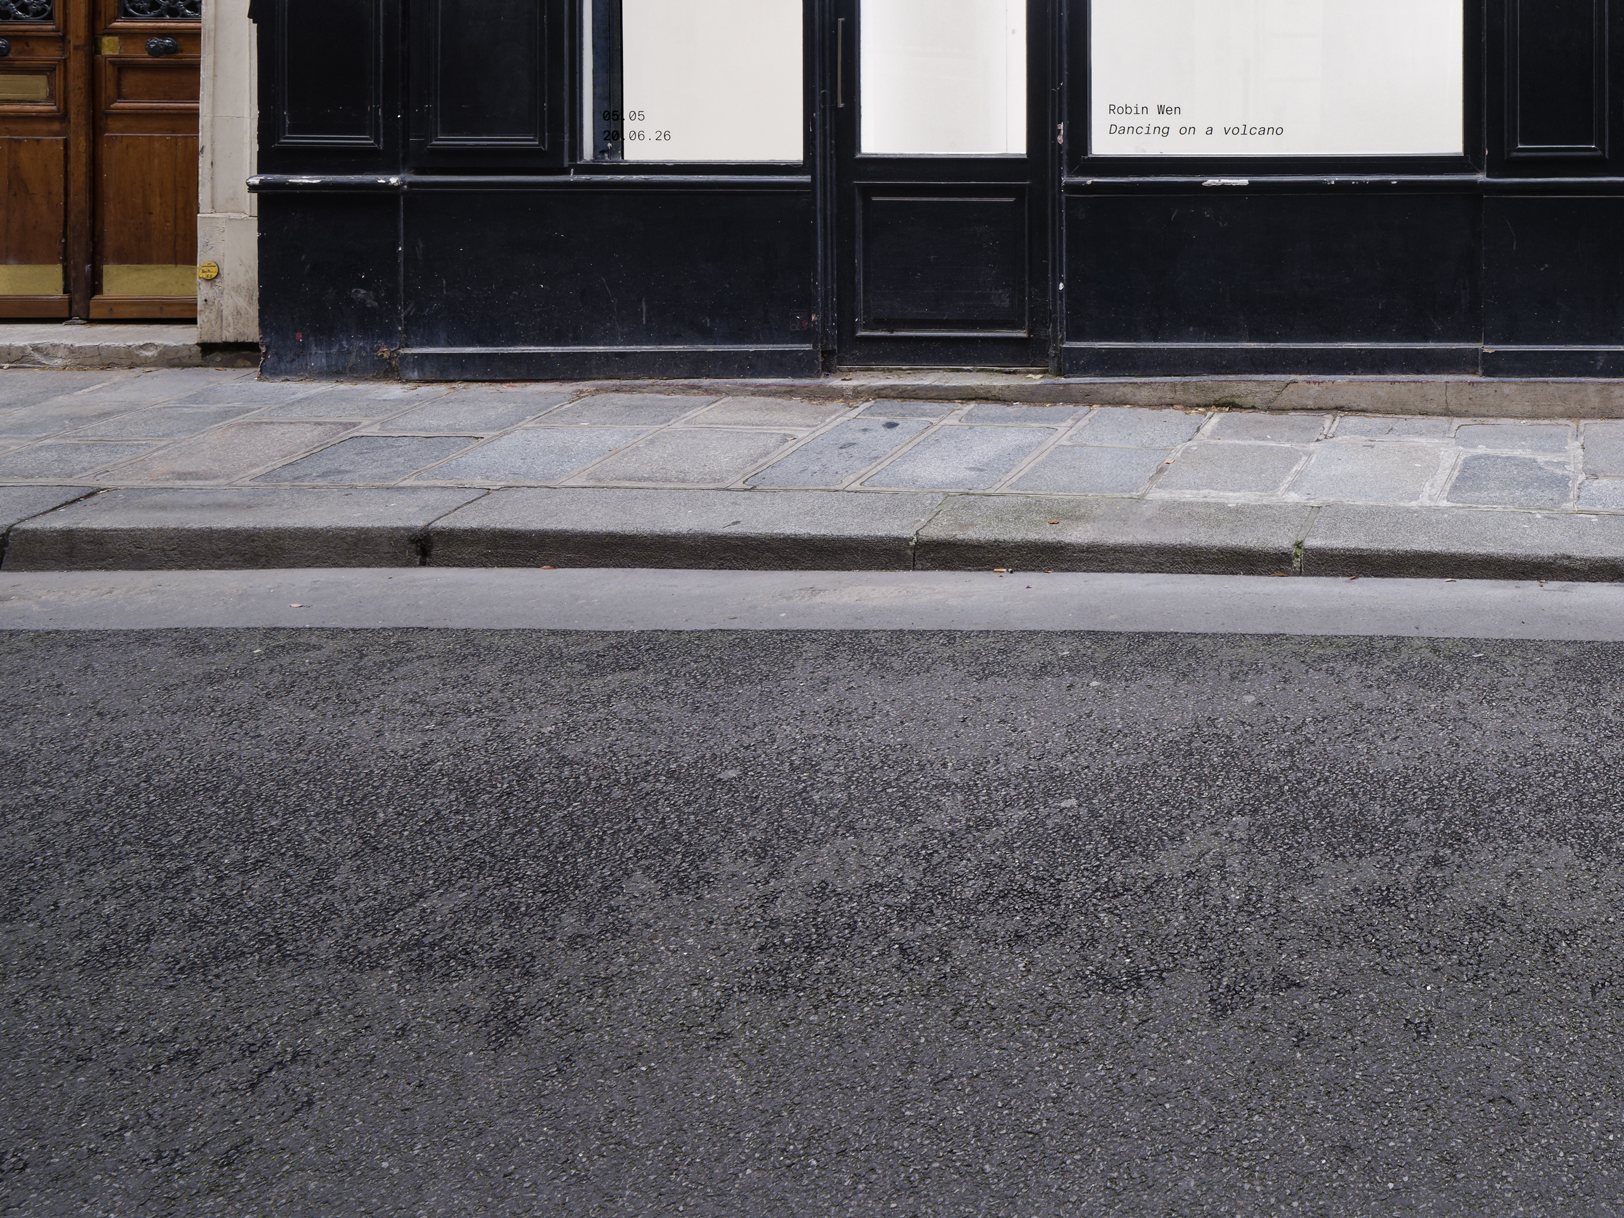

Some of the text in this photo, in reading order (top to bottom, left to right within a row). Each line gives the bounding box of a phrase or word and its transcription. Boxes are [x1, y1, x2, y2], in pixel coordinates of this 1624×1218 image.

[1109, 104, 1181, 115] Robin Wen
[602, 110, 645, 121] 05.05
[603, 130, 671, 141] 20.06.26
[1109, 124, 1283, 137] Dancing on a volcano
